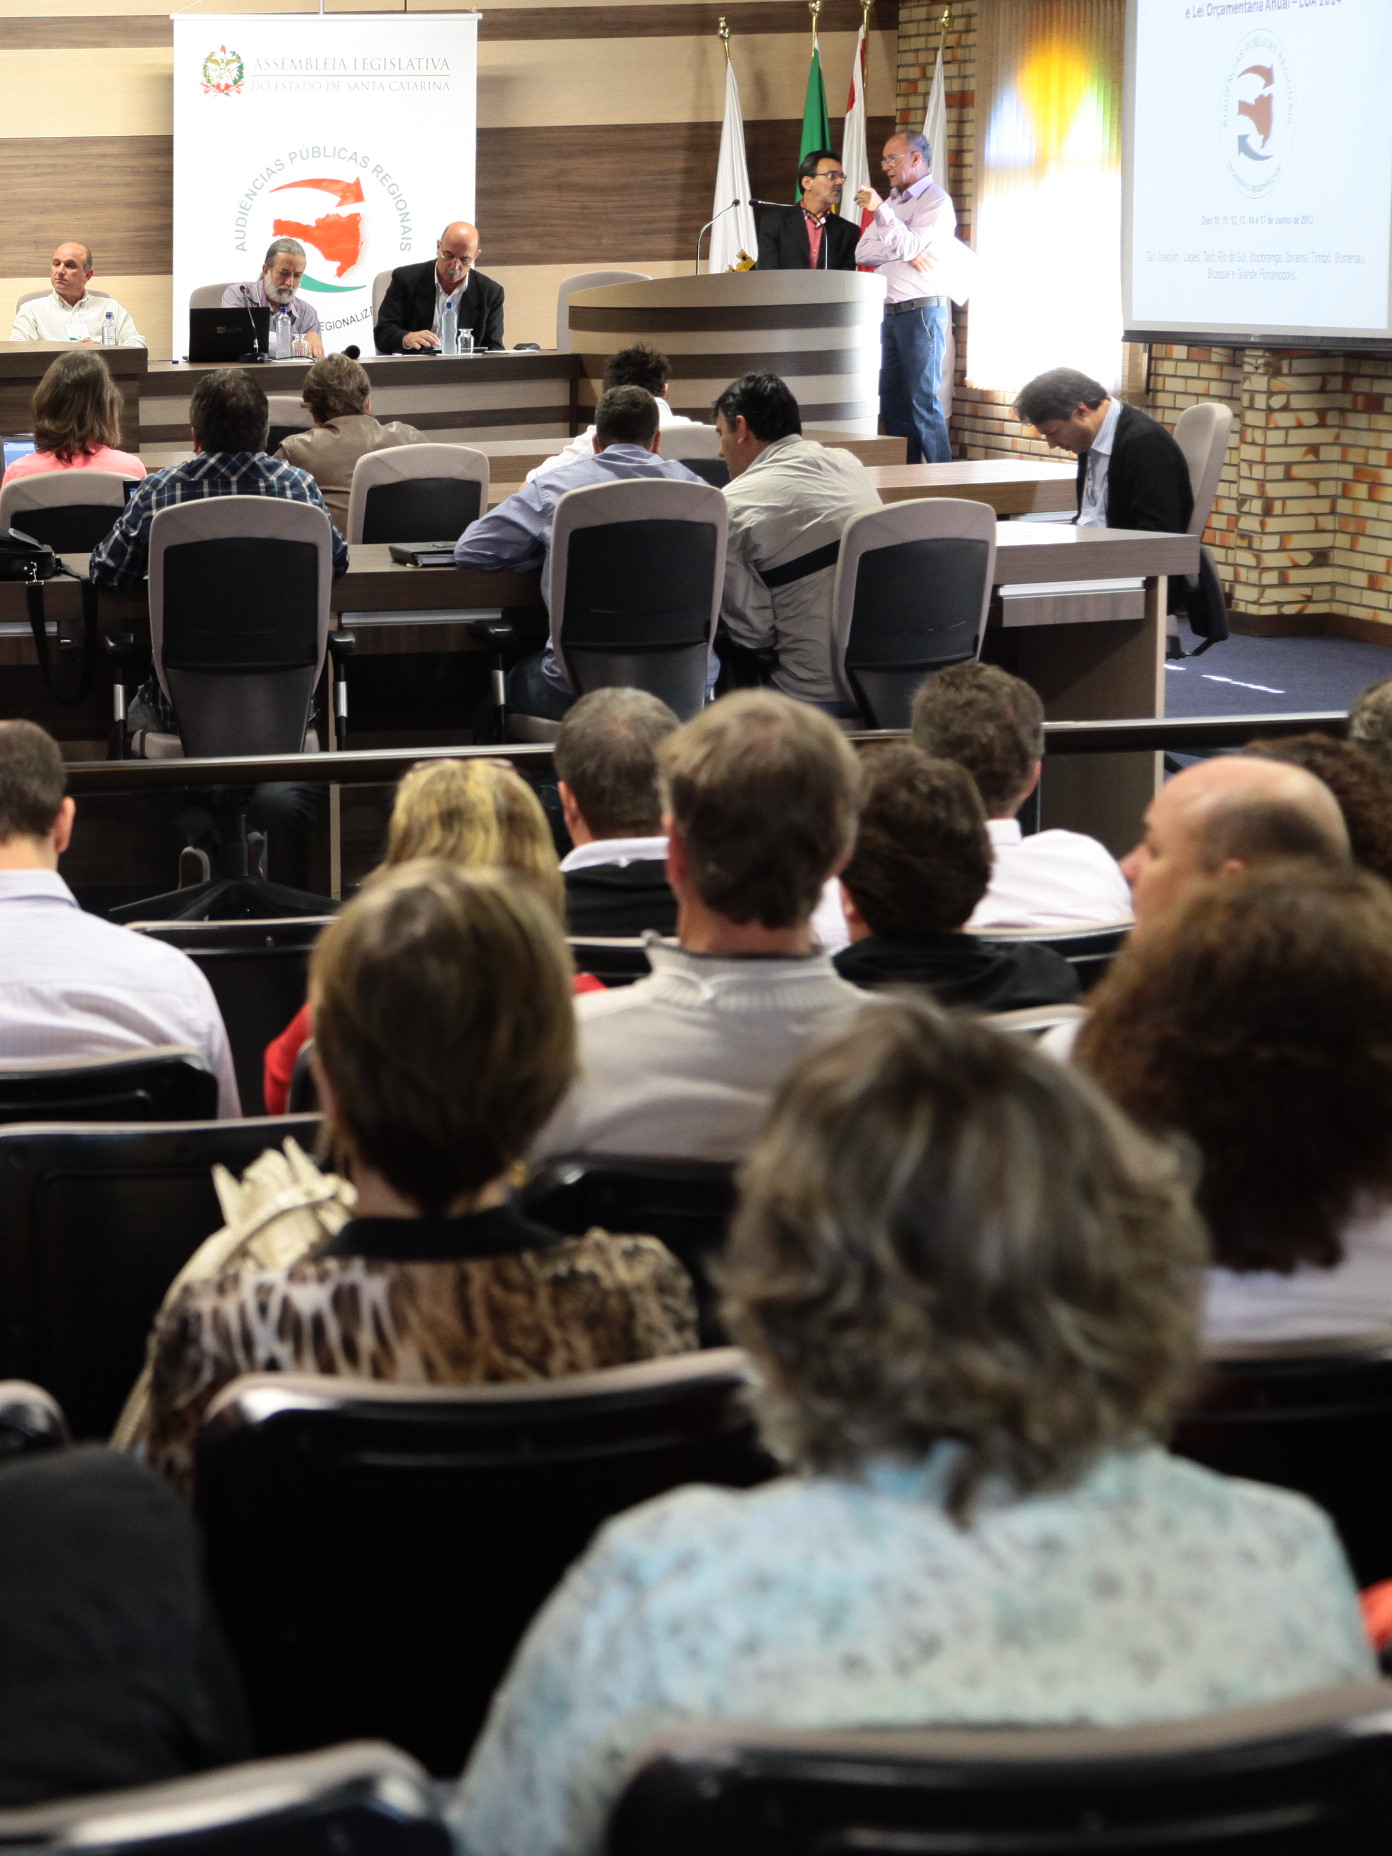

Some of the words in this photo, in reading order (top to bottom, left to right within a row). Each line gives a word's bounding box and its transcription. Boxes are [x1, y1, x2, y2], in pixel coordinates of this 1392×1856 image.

[1192, 3, 1205, 18] Lei
[1265, 0, 1290, 11] Anual
[253, 57, 348, 71] ASSEMBLEIA
[353, 57, 450, 71] LEGISLATIVA
[251, 80, 270, 92] DO
[275, 80, 322, 92] ESTADO
[326, 80, 342, 92] DE
[346, 80, 385, 92] SANTA
[389, 80, 450, 92] CATARINA
[234, 158, 285, 253] AUDIÊNCIAS
[288, 145, 370, 169] PÚBLICAS
[371, 164, 413, 252] REGIONAIS
[319, 306, 373, 331] EGIONALIZ
